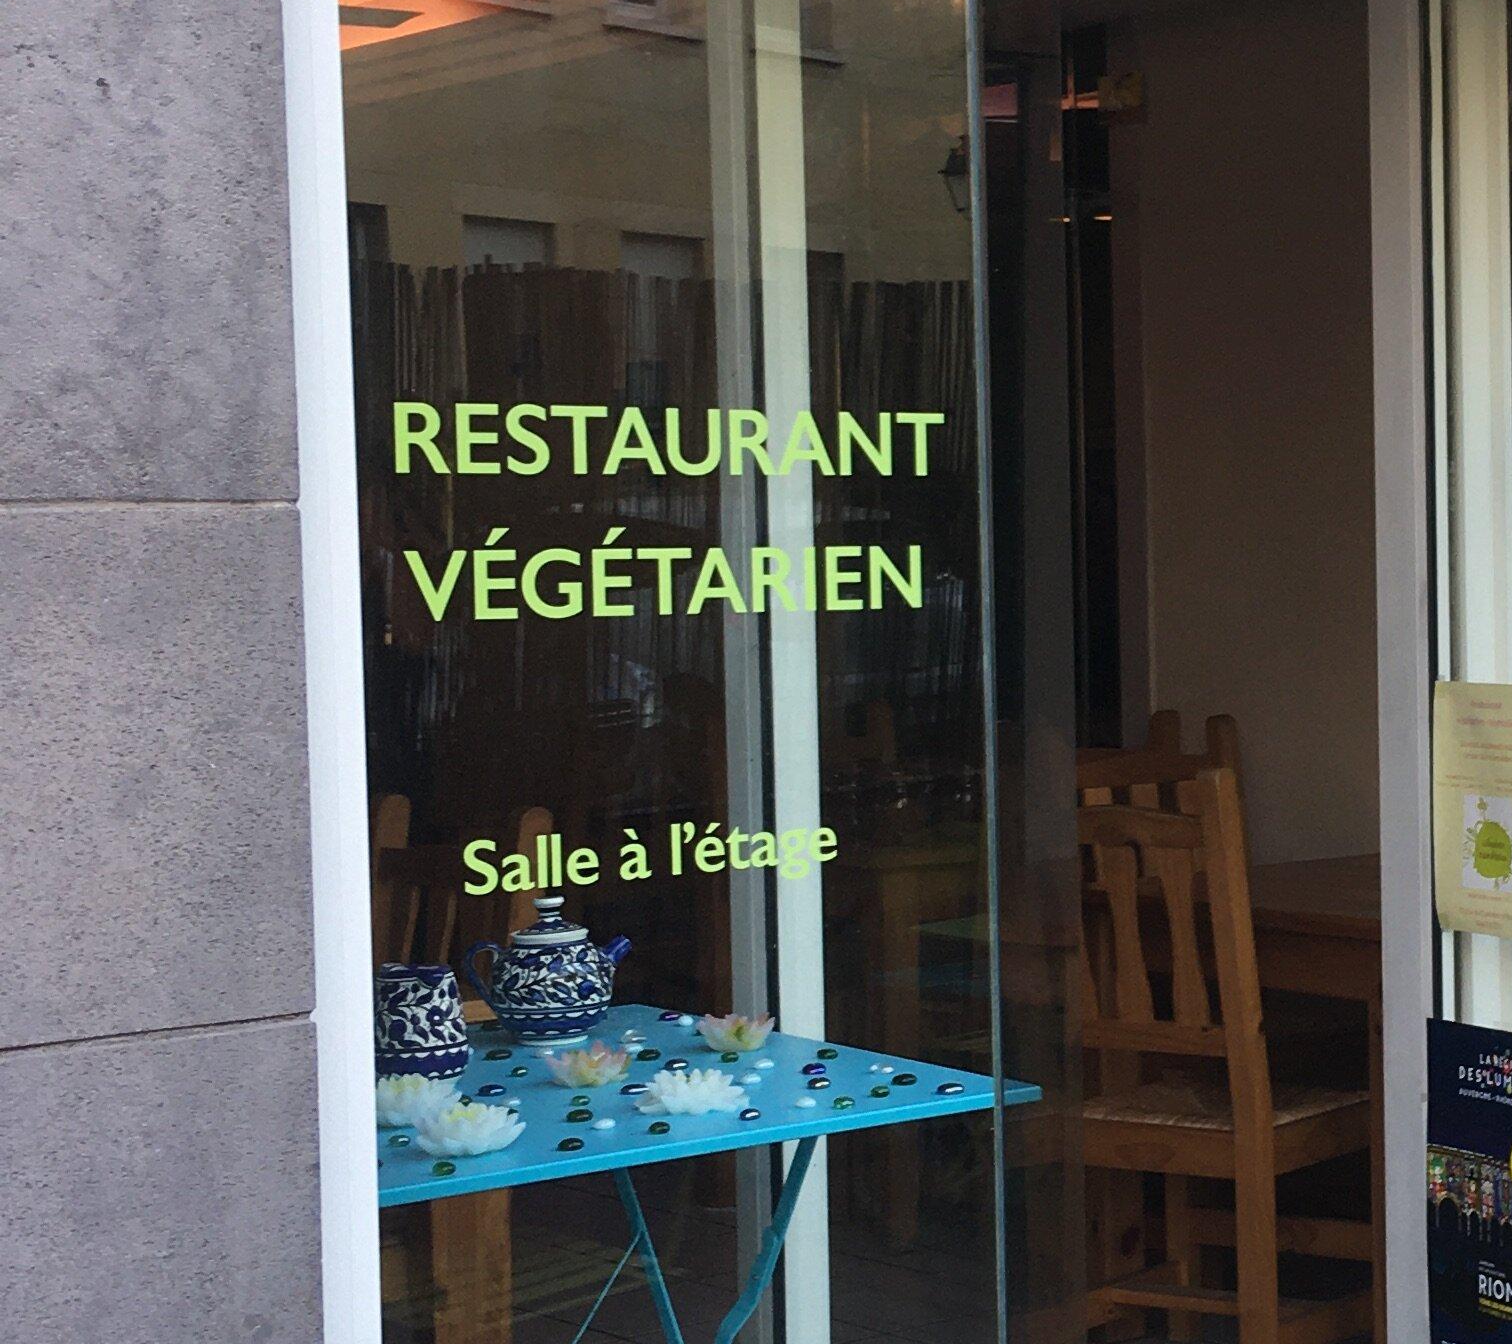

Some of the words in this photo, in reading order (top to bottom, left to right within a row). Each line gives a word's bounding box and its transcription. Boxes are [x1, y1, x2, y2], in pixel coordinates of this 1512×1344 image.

[393, 401, 944, 476] RESTAURANT
[403, 527, 923, 622] VÉGÉTARIEN
[462, 833, 599, 896] Salle
[619, 829, 652, 882] à
[671, 821, 838, 880] l'étage
